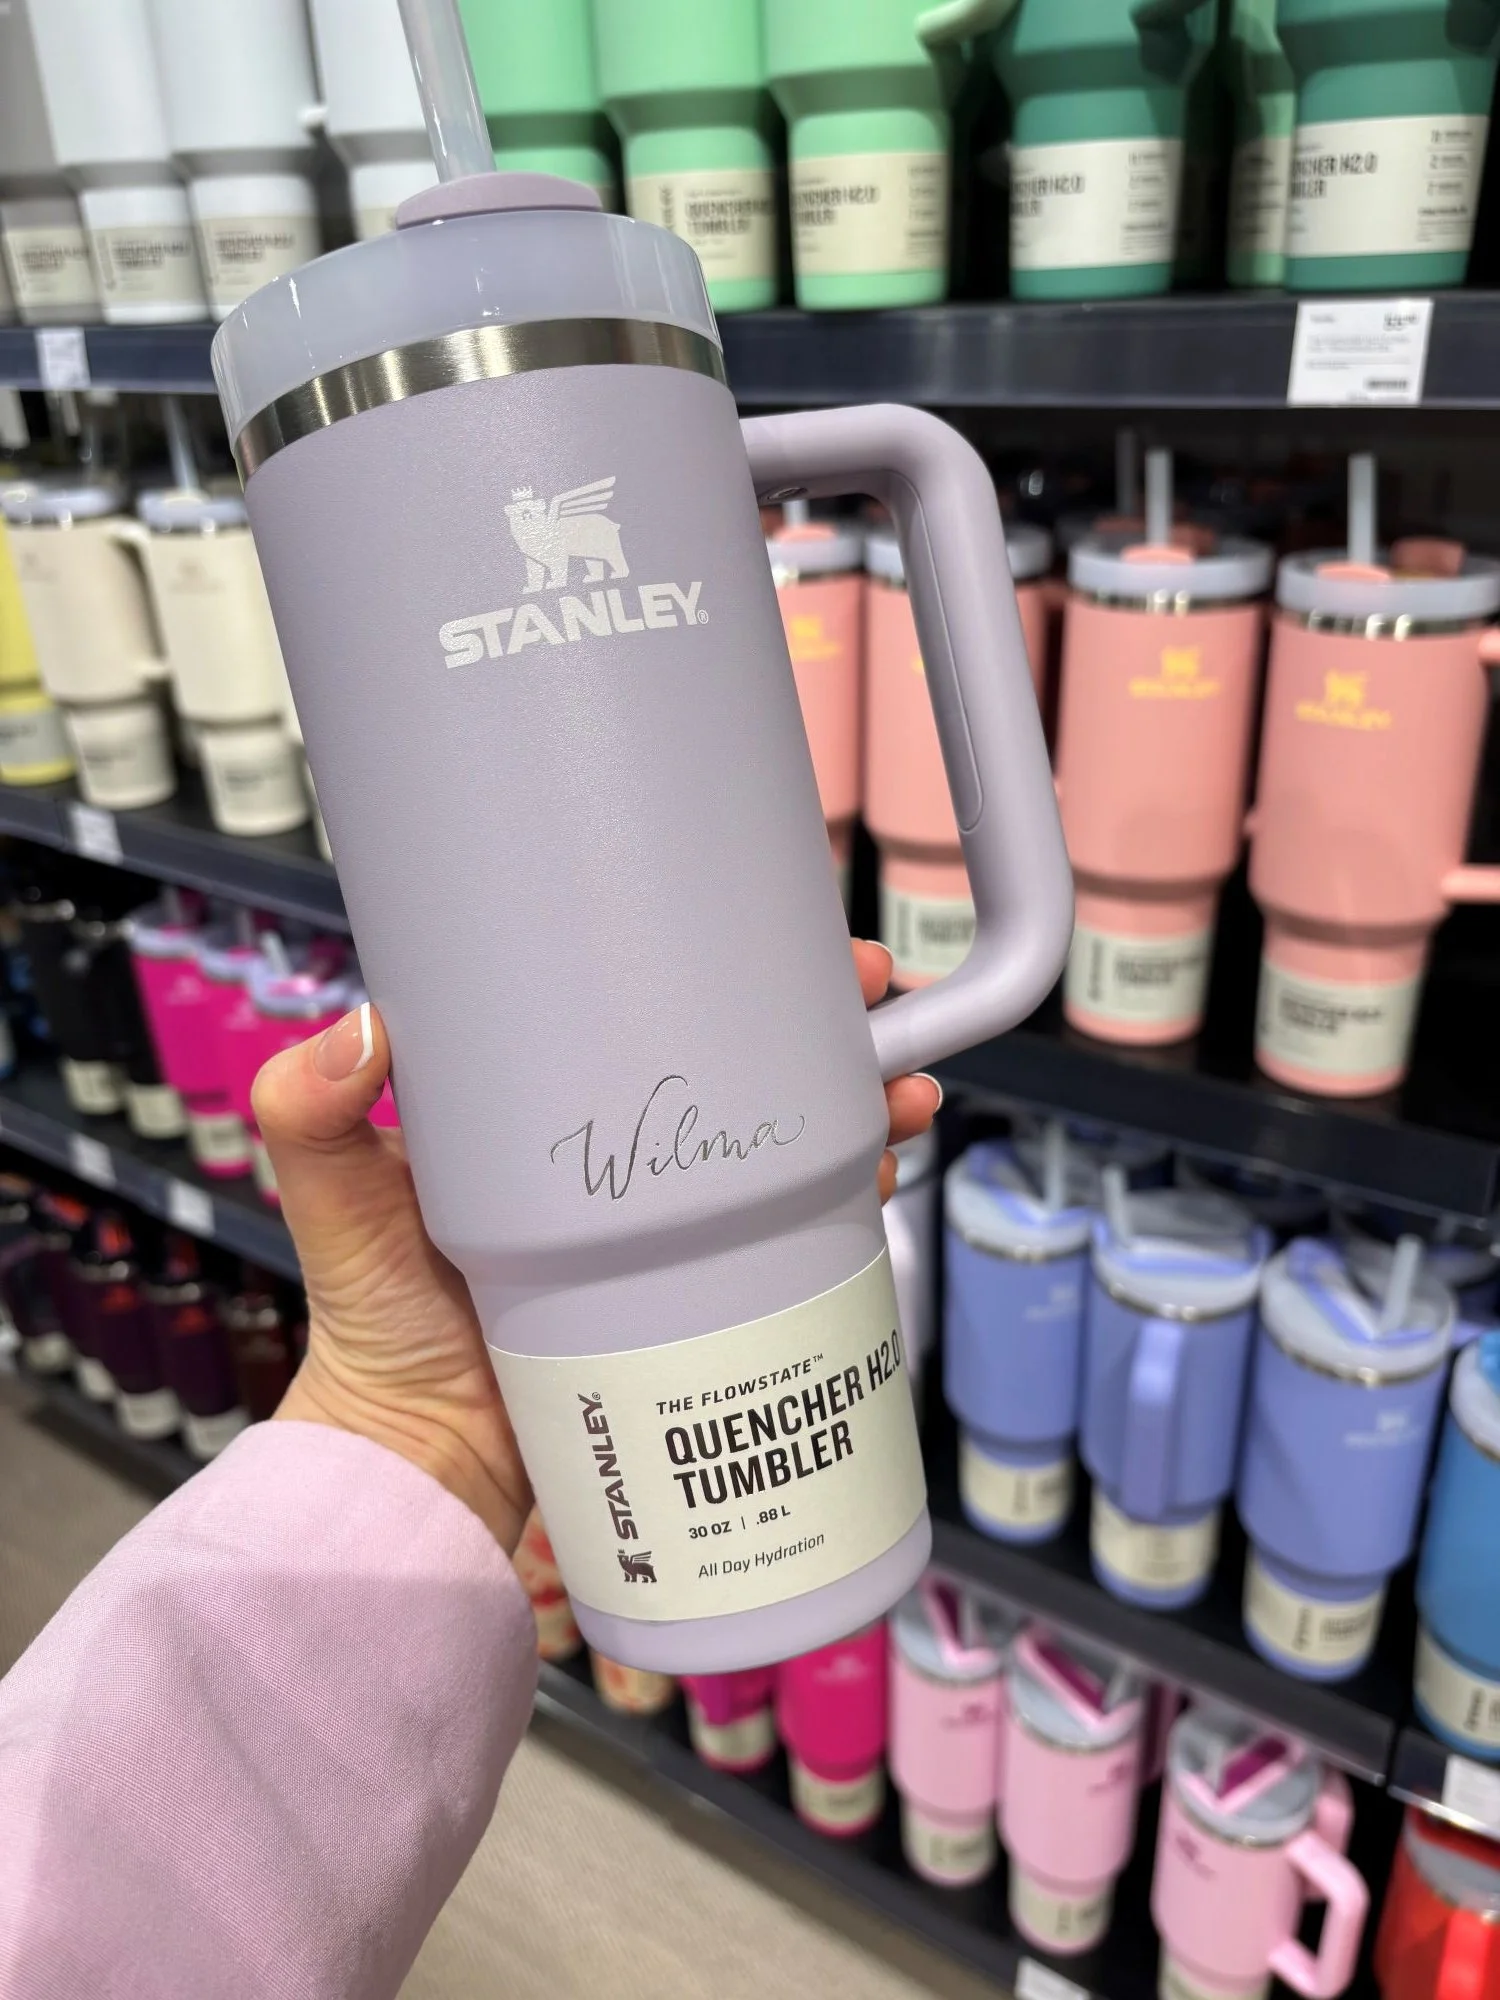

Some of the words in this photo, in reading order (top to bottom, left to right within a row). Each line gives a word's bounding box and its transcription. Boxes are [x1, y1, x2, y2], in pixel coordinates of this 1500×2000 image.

[550, 1074, 805, 1200] Wilma
[656, 1395, 694, 1415] THE
[664, 1364, 865, 1466] QUENCHER
[866, 1328, 901, 1392] H2.0
[672, 1419, 854, 1509] TUMBLER
[688, 1526, 708, 1539] 30
[711, 1520, 732, 1535] OZ
[756, 1508, 778, 1525] .88
[780, 1504, 791, 1517] L
[698, 1562, 718, 1578] All
[722, 1559, 751, 1573] Day
[754, 1533, 825, 1567] Hydration
